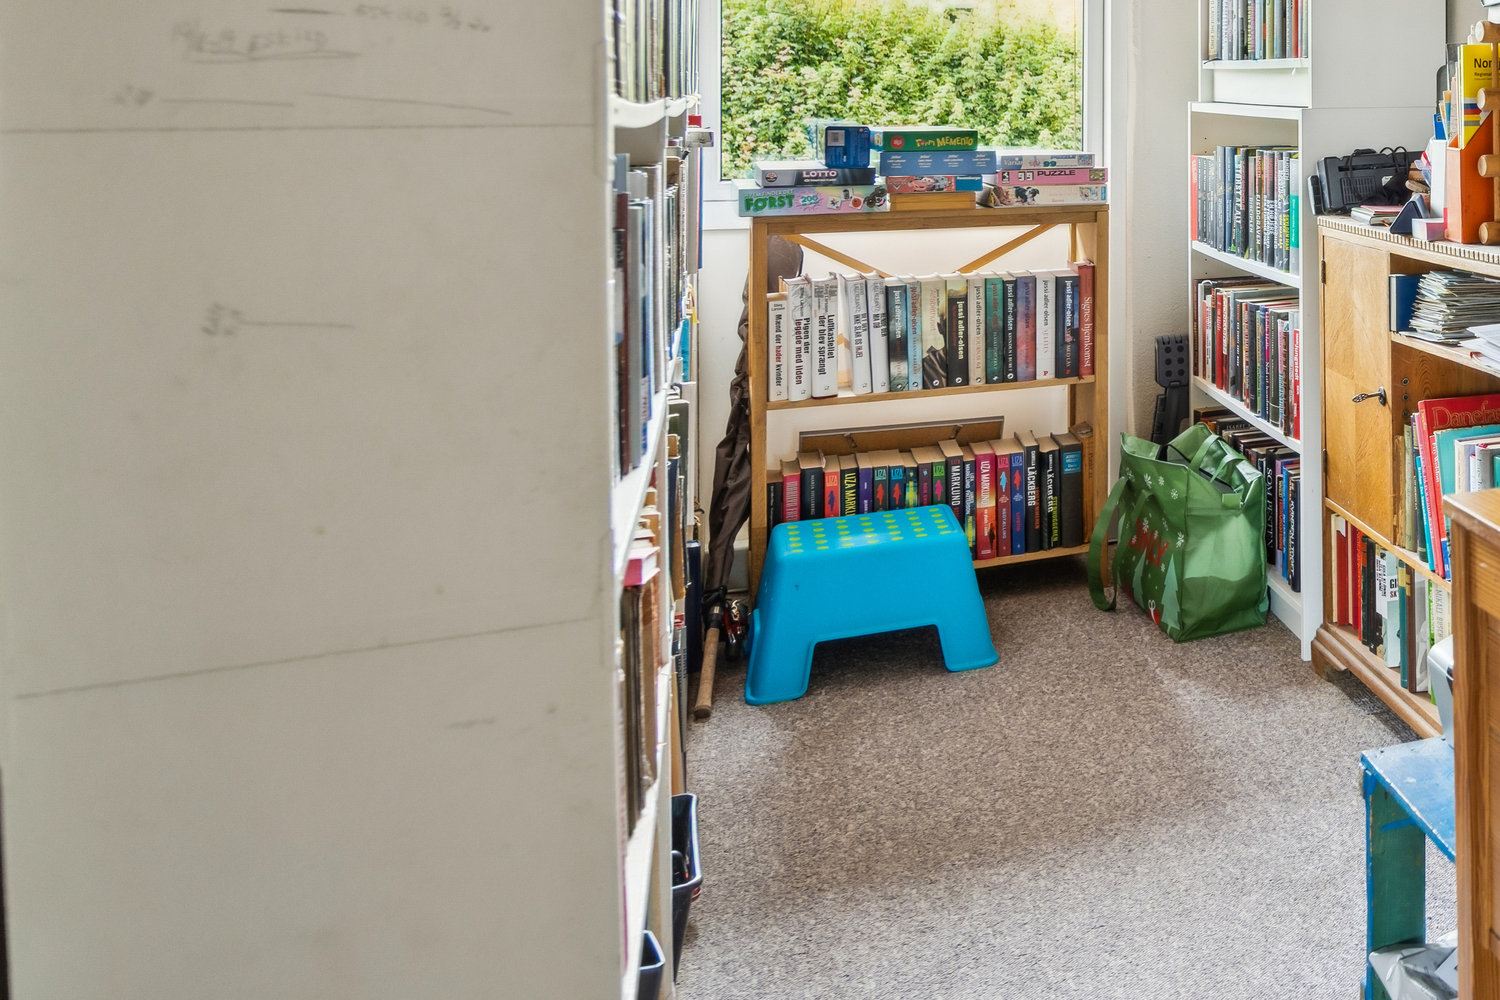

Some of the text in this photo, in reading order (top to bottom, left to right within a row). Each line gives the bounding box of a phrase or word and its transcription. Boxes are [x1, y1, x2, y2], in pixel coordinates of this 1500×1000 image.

[936, 136, 974, 148] MEMENTO
[744, 195, 795, 212] FØRST
[892, 290, 902, 305] jussi
[910, 286, 918, 301] jussi
[974, 285, 982, 300] jussi
[1006, 283, 1014, 297] jussi
[1024, 281, 1032, 297] jussi
[1042, 280, 1050, 293] jussi
[1064, 280, 1072, 294] jussi
[956, 301, 964, 318] jussi
[974, 301, 982, 335] adler-olsen
[992, 297, 1000, 330] adler-olsen
[1024, 297, 1032, 329] adler-olsen
[1066, 294, 1074, 327] adler-olsen
[794, 319, 802, 344] legede
[802, 318, 810, 340] Pigen
[894, 306, 902, 339] adler-olsen
[1082, 296, 1092, 367] Signes hjemkomst
[818, 315, 826, 376] der blev sprængt
[826, 314, 836, 359] Luftkastellet
[776, 345, 784, 362] hader
[796, 347, 804, 363] med
[856, 346, 864, 358] IHJEL
[776, 364, 784, 386] kvinder
[980, 460, 990, 473] LIZA
[844, 472, 856, 516] LIZA MARKL
[950, 465, 960, 506] MARKLUND
[980, 473, 990, 505] MARKLUND
[1026, 466, 1038, 506] LÄCKBERG
[1046, 469, 1054, 513] LÄCKBERG
